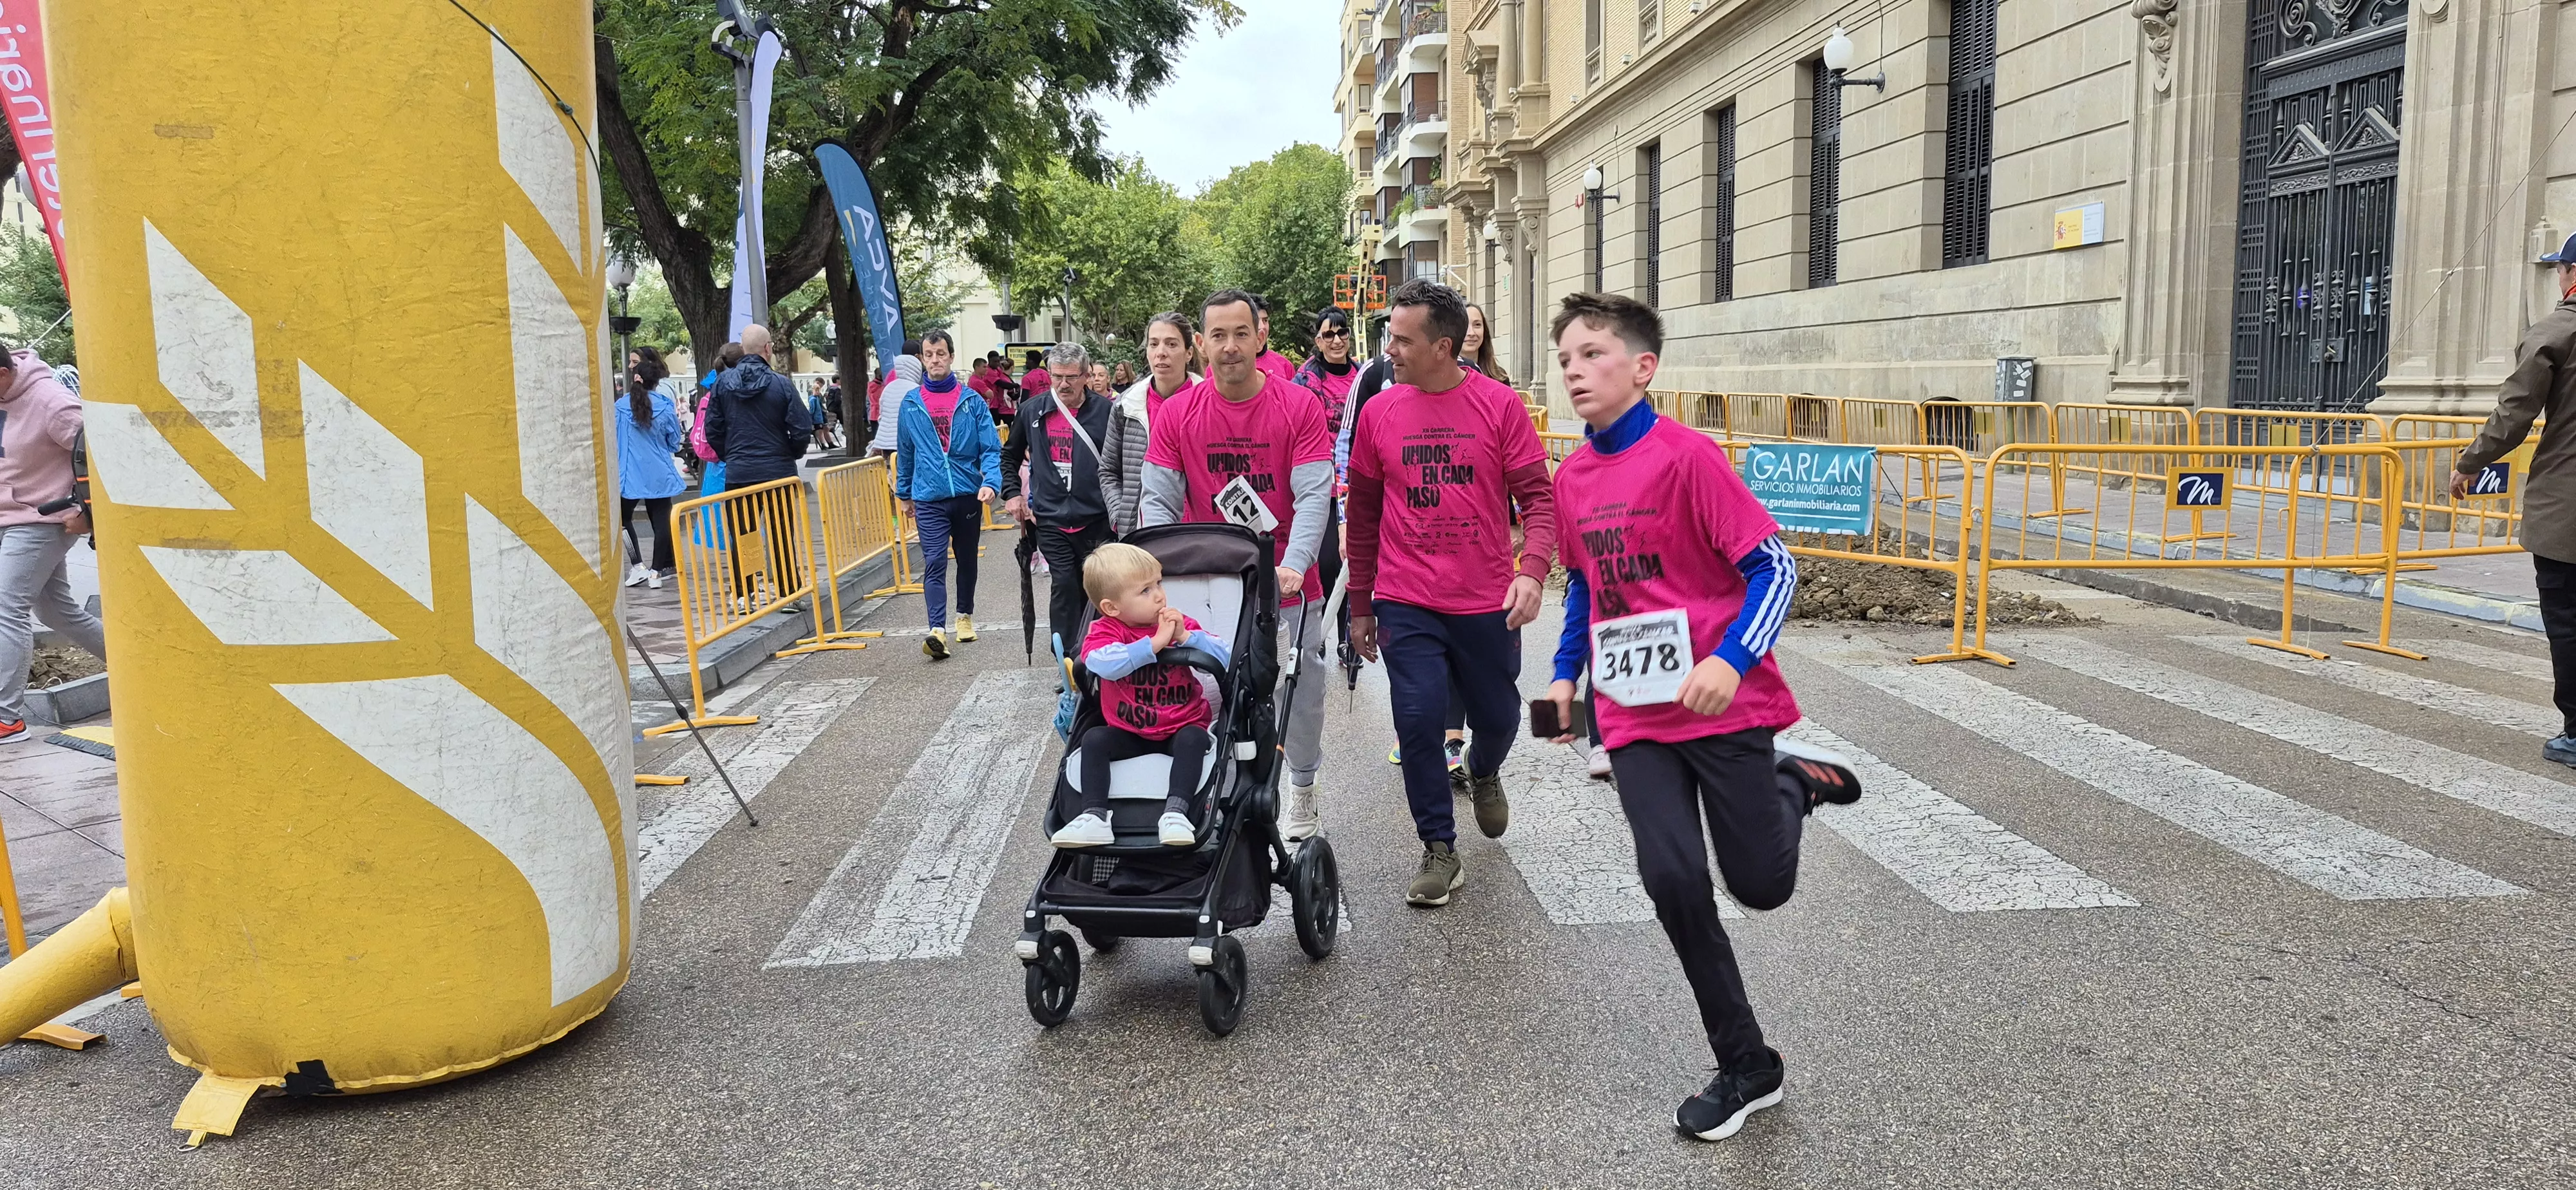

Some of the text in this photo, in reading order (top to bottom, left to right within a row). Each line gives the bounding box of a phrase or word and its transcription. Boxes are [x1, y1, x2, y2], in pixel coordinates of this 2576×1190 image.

[1207, 453, 1251, 473] UNIDOS
[1402, 444, 1450, 466] UNIDOS
[1422, 465, 1473, 485] EN CADA
[1752, 451, 1866, 484] GARLAN
[1406, 486, 1441, 508] PASO
[1750, 480, 1862, 496] SERVICIOS INMOBILIARIOS
[1616, 553, 1665, 583] CADA
[1602, 643, 1680, 681] 3478
[1134, 687, 1156, 707] EN
[1117, 701, 1158, 729] PASO
